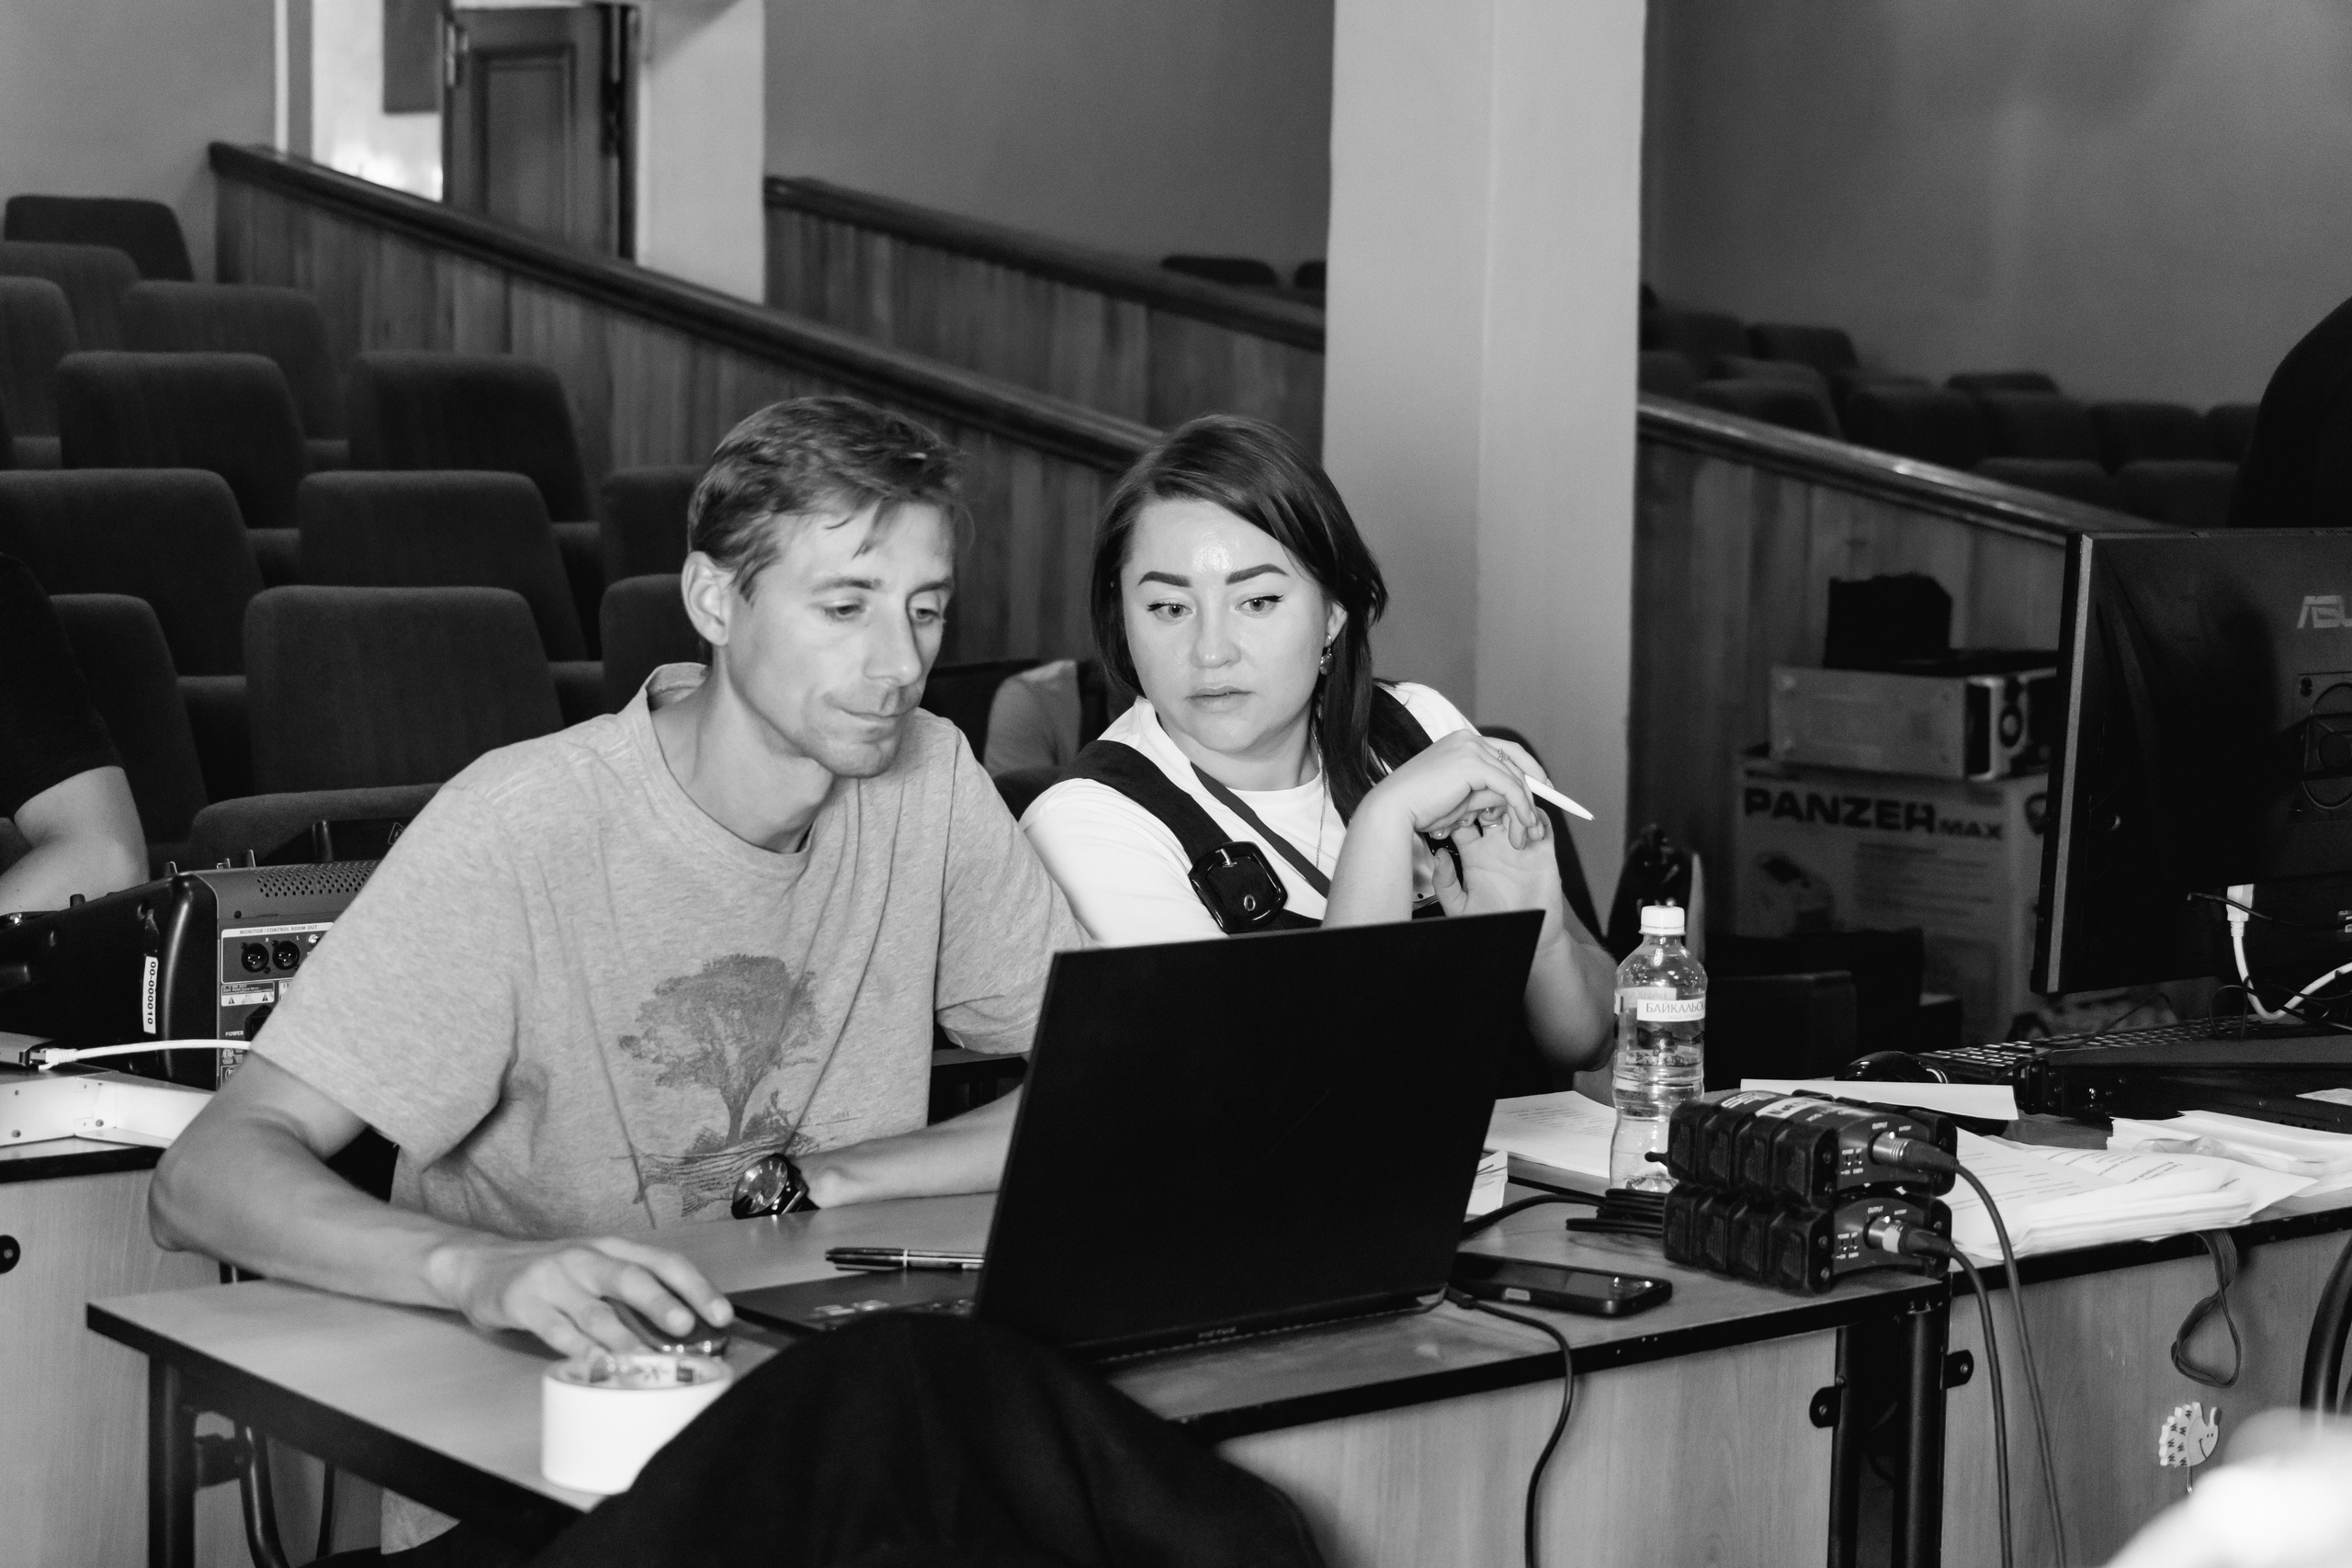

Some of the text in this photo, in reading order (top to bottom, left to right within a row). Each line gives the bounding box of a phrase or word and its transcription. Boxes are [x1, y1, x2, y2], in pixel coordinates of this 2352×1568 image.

[1744, 787, 1936, 833] PANZER
[1939, 818, 2003, 840] MAX
[147, 961, 156, 1024] 00-000010
